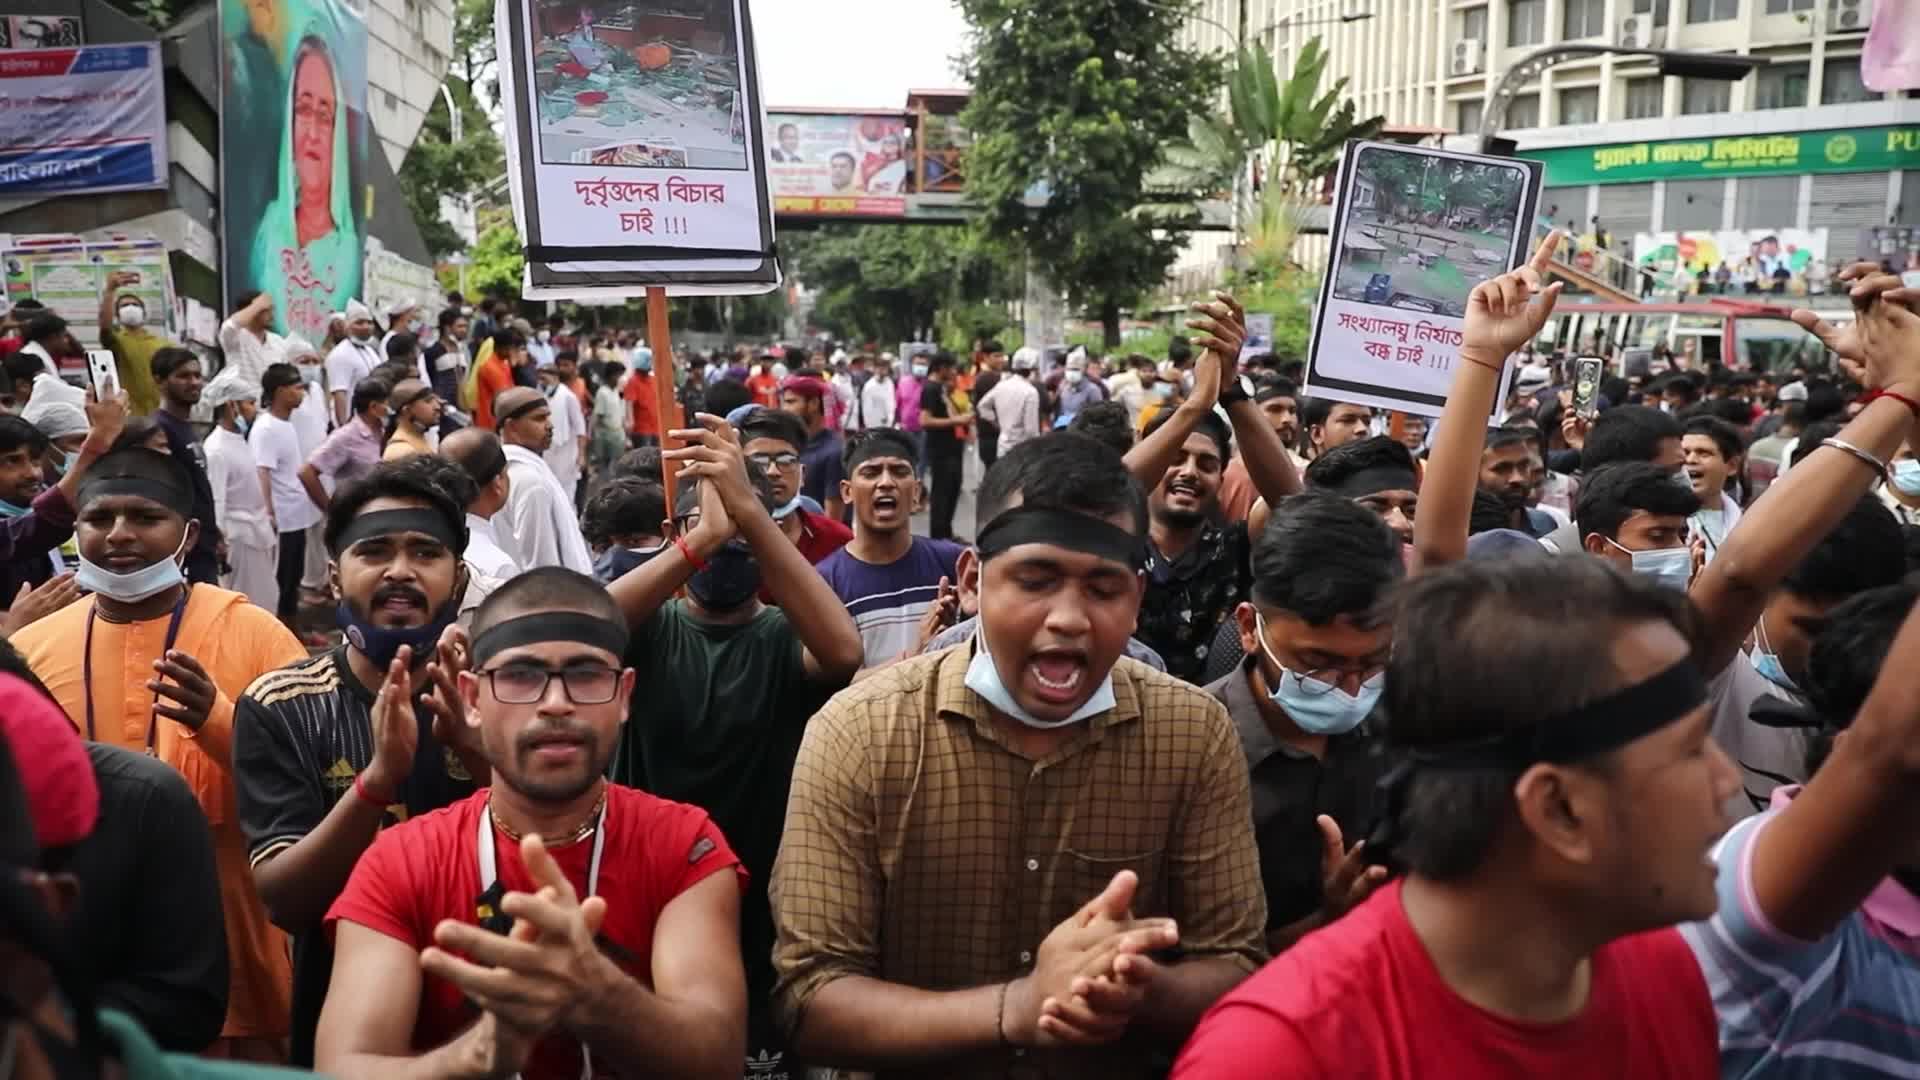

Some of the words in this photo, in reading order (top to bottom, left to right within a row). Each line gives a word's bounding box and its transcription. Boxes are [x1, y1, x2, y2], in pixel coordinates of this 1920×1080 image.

[665, 175, 725, 203] বিচার
[620, 208, 654, 234] চাই
[664, 216, 688, 234] !!!
[1337, 312, 1410, 343] সংখ্যালঘু
[1414, 320, 1464, 347] নির্যাত
[1364, 340, 1392, 361] বন্ধ
[1396, 344, 1424, 367] চাই
[1429, 353, 1451, 371] !!!
